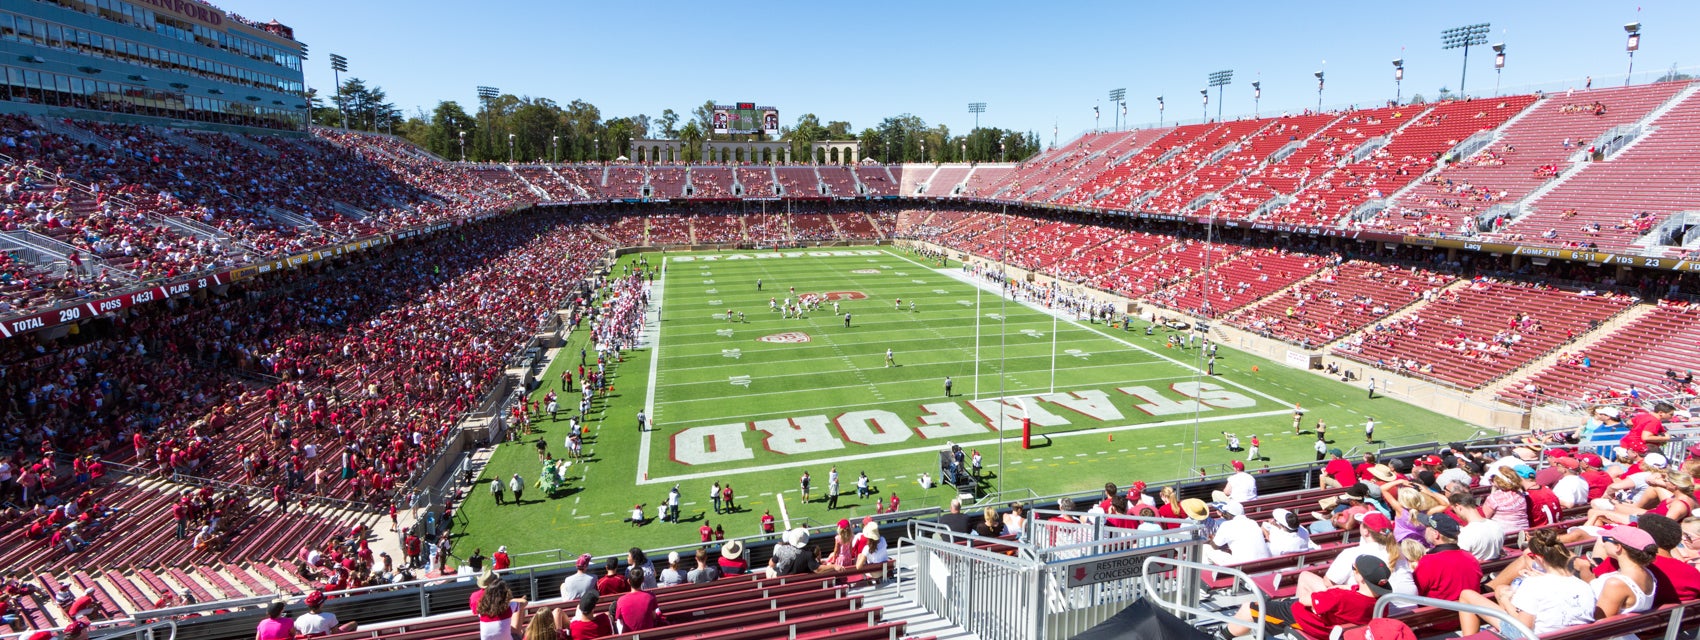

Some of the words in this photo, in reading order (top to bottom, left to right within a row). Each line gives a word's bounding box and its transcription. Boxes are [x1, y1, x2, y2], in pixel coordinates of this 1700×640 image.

[1464, 242, 1481, 251] Lacy
[1521, 248, 1560, 257] COMP-ATT
[1572, 251, 1595, 261] 6-11
[1616, 256, 1633, 264] YDS
[1645, 258, 1660, 267] 23
[12, 317, 44, 333] TOTAL
[59, 307, 80, 323] 290
[100, 298, 122, 312] POSS
[131, 290, 153, 305] 14:31
[170, 283, 190, 295] PLAYS
[197, 278, 207, 288] 33
[669, 381, 1256, 466] STANFORD
[1093, 564, 1150, 581] CONCESSIO
[1096, 556, 1148, 571] RESTROOM
